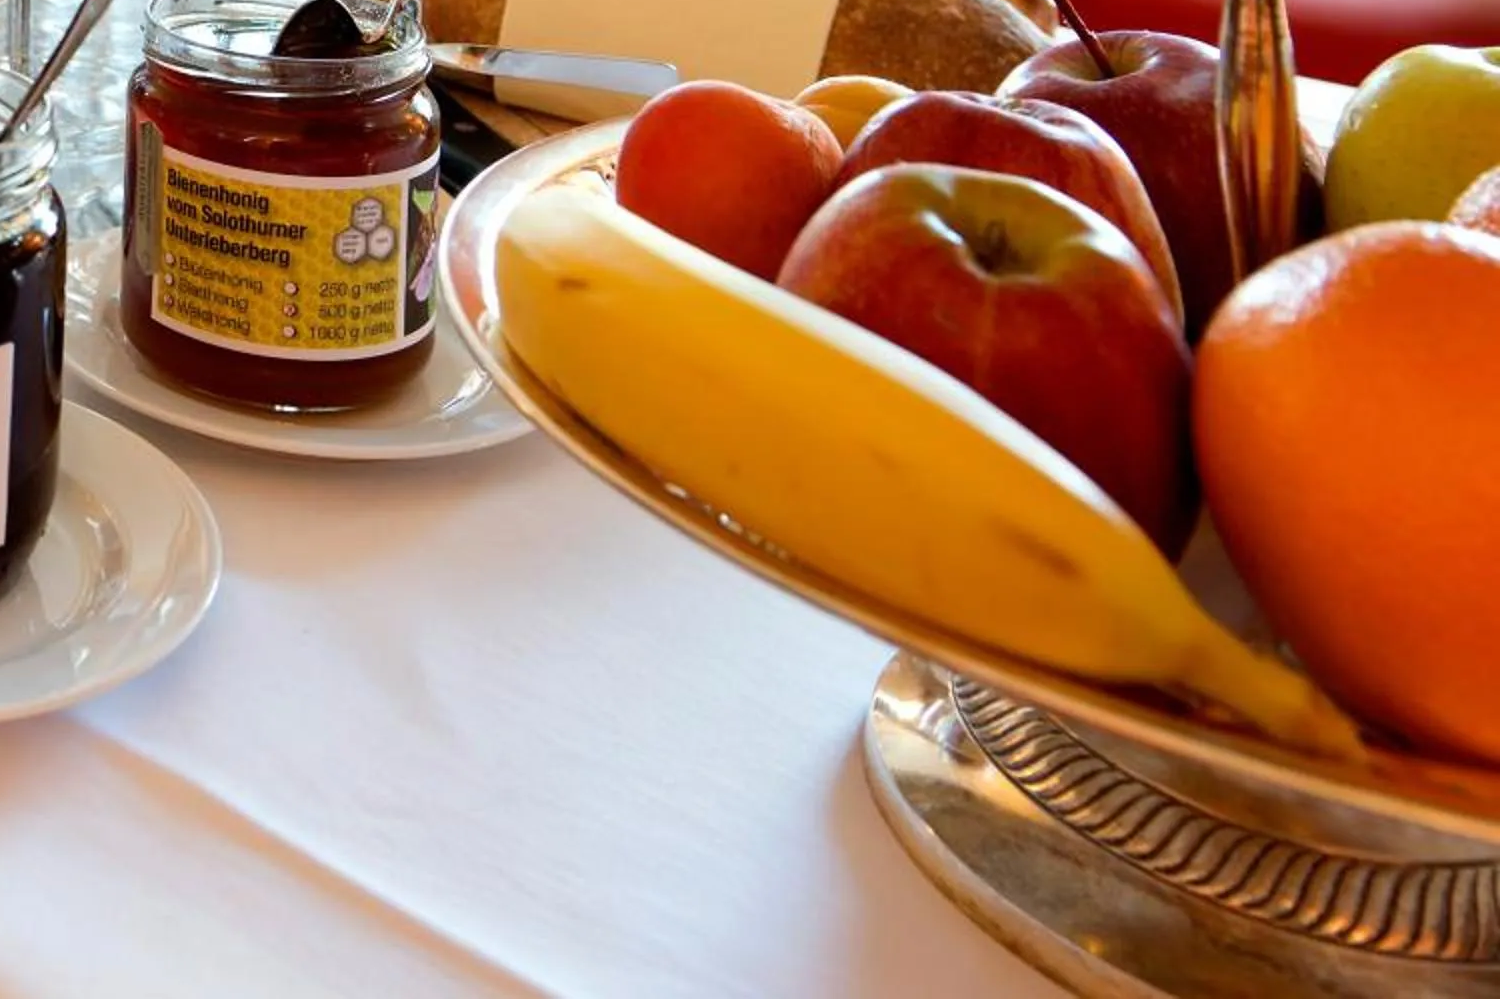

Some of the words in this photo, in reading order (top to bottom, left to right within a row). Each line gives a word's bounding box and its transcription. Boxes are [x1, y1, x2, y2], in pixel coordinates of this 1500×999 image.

[167, 168, 269, 214] Bienenhonig
[167, 196, 197, 219] vom
[202, 204, 308, 240] Solothurner
[165, 217, 291, 268] Unterleberberg
[319, 282, 347, 298] 250
[351, 284, 361, 298] g
[318, 303, 347, 319] 500
[350, 305, 360, 319] g
[363, 300, 394, 315] netto
[310, 326, 346, 340] 1000
[350, 327, 359, 342] g
[364, 321, 394, 337] netto
